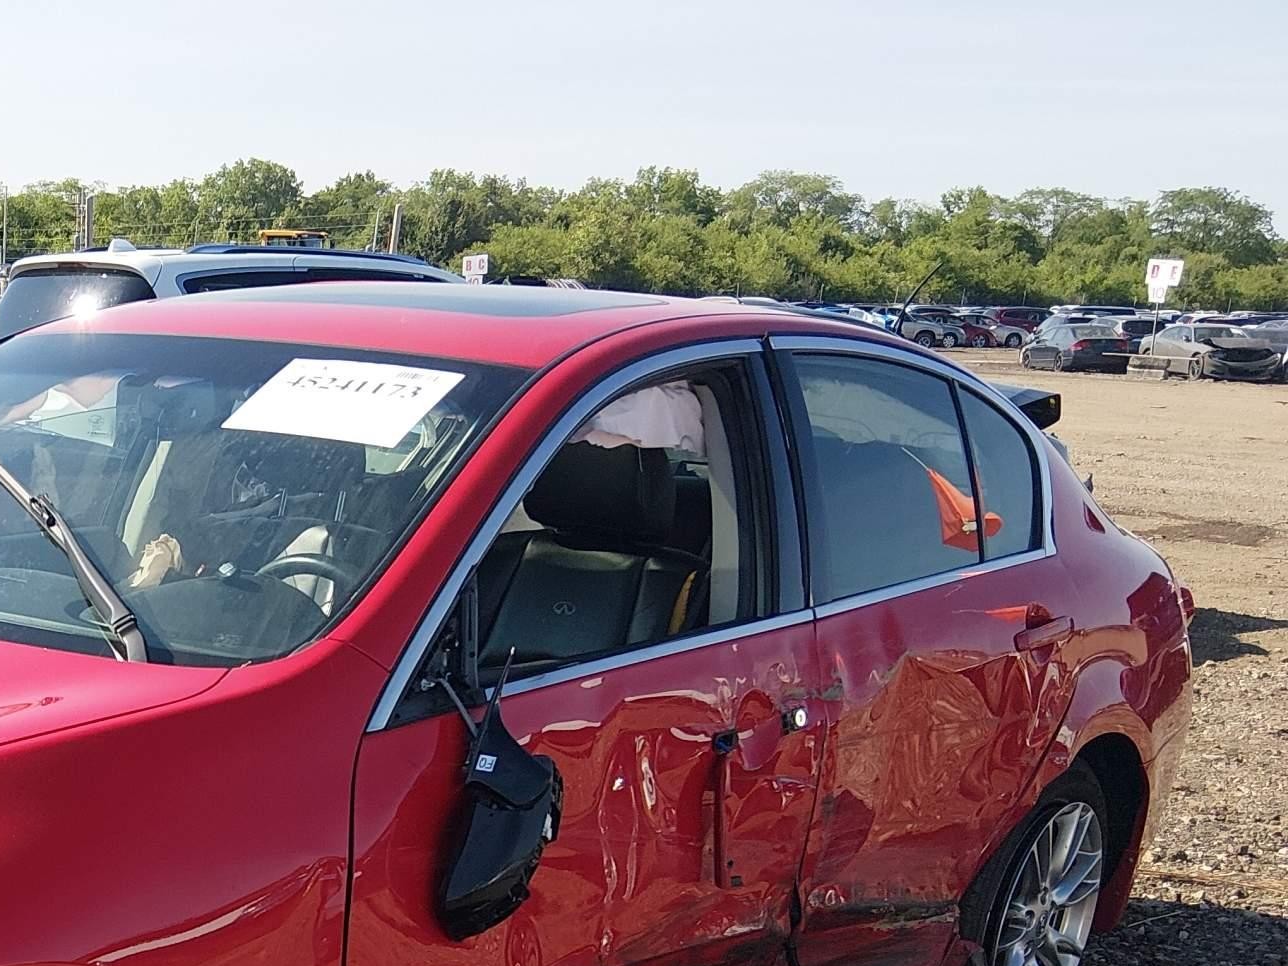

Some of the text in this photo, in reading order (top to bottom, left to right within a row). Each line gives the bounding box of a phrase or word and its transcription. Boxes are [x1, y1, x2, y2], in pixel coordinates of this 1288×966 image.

[465, 258, 485, 272] B C
[1150, 264, 1160, 279] D
[287, 375, 423, 400] 45241173
